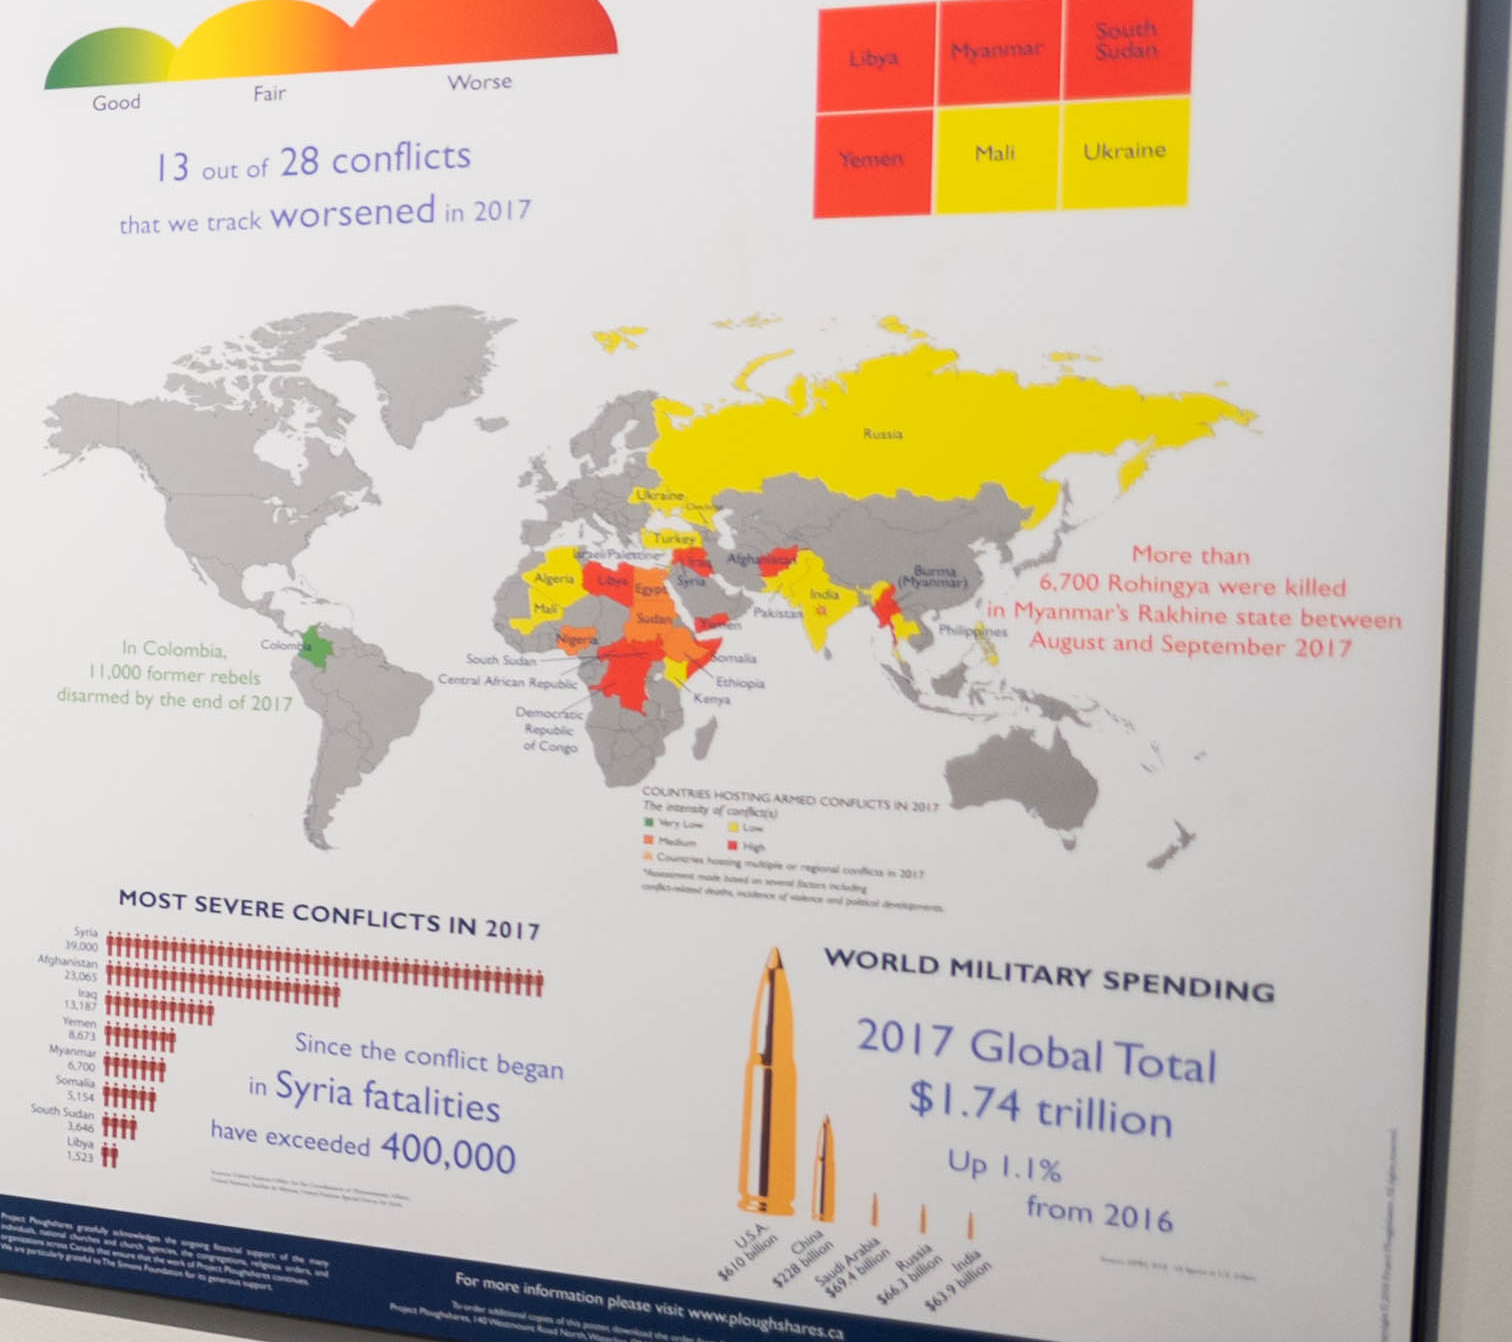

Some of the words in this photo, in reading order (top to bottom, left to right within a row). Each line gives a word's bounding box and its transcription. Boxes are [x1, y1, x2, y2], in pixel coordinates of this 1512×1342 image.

[255, 85, 286, 101] Fair
[448, 75, 512, 90] Worse
[93, 94, 140, 111] Good
[160, 153, 187, 181] 13
[203, 165, 237, 179] out
[248, 158, 268, 177] of
[282, 146, 318, 176] 28
[333, 141, 470, 173] conflicts
[121, 216, 160, 234] that
[168, 219, 198, 231] we
[208, 211, 261, 231] track
[270, 194, 435, 228] worsened
[446, 206, 465, 223] in
[475, 199, 531, 221] 2017
[1133, 545, 1192, 563] More
[1202, 547, 1250, 565] than
[1040, 573, 1099, 591] 6,700
[1109, 574, 1209, 599] Rohingya
[1219, 582, 1276, 595] were
[1285, 578, 1347, 597] killed
[986, 601, 1006, 619] in
[1015, 601, 1128, 623] Myanmar's
[1139, 604, 1227, 624] Rakhine
[1237, 612, 1291, 626] state
[1301, 608, 1402, 629] between
[123, 640, 136, 654] In
[143, 640, 227, 659] Colombia,
[1030, 631, 1104, 654] August
[1114, 635, 1152, 651] and
[1162, 635, 1286, 659] September
[1296, 638, 1352, 658] 2017
[91, 664, 141, 680] 11,000
[147, 665, 205, 682] former
[211, 670, 261, 685] rebels
[57, 687, 129, 704] disarmed
[136, 691, 154, 710] by
[160, 692, 186, 707] the
[192, 694, 222, 709] end
[229, 695, 246, 710] of
[251, 695, 293, 712] 2017
[120, 890, 187, 910] MOST
[196, 896, 283, 919] SEVERE
[293, 904, 440, 932] CONFLICTS
[450, 917, 476, 935] IN
[487, 920, 539, 940] 2017
[825, 948, 939, 974] WORLD
[951, 959, 1091, 987] MILITARY
[1104, 971, 1274, 1003] SPENDING
[296, 1032, 352, 1057] Since
[361, 1040, 396, 1062] the
[405, 1048, 488, 1072] conflict
[497, 1054, 563, 1083] began
[860, 1019, 953, 1056] 2017
[971, 1030, 1102, 1072] Global
[1115, 1042, 1215, 1083] Total
[249, 1076, 267, 1096] in
[277, 1070, 352, 1108] Syria
[364, 1080, 500, 1123] fatalities
[911, 1080, 1020, 1122] $1.74
[1038, 1097, 1171, 1138] trillion
[212, 1119, 257, 1142] have
[266, 1132, 369, 1156] exceeded
[381, 1132, 515, 1174] 400,000
[949, 1149, 987, 1180] Up
[1004, 1155, 1062, 1182] 1.1%
[1027, 1195, 1092, 1223] from
[1106, 1203, 1173, 1232] 2016
[456, 1272, 480, 1287] For
[483, 1279, 520, 1293] more
[524, 1283, 603, 1305] information
[608, 1295, 651, 1312] please
[655, 1303, 684, 1317] visit
[688, 1309, 844, 1340] www.ploughshares.ca
